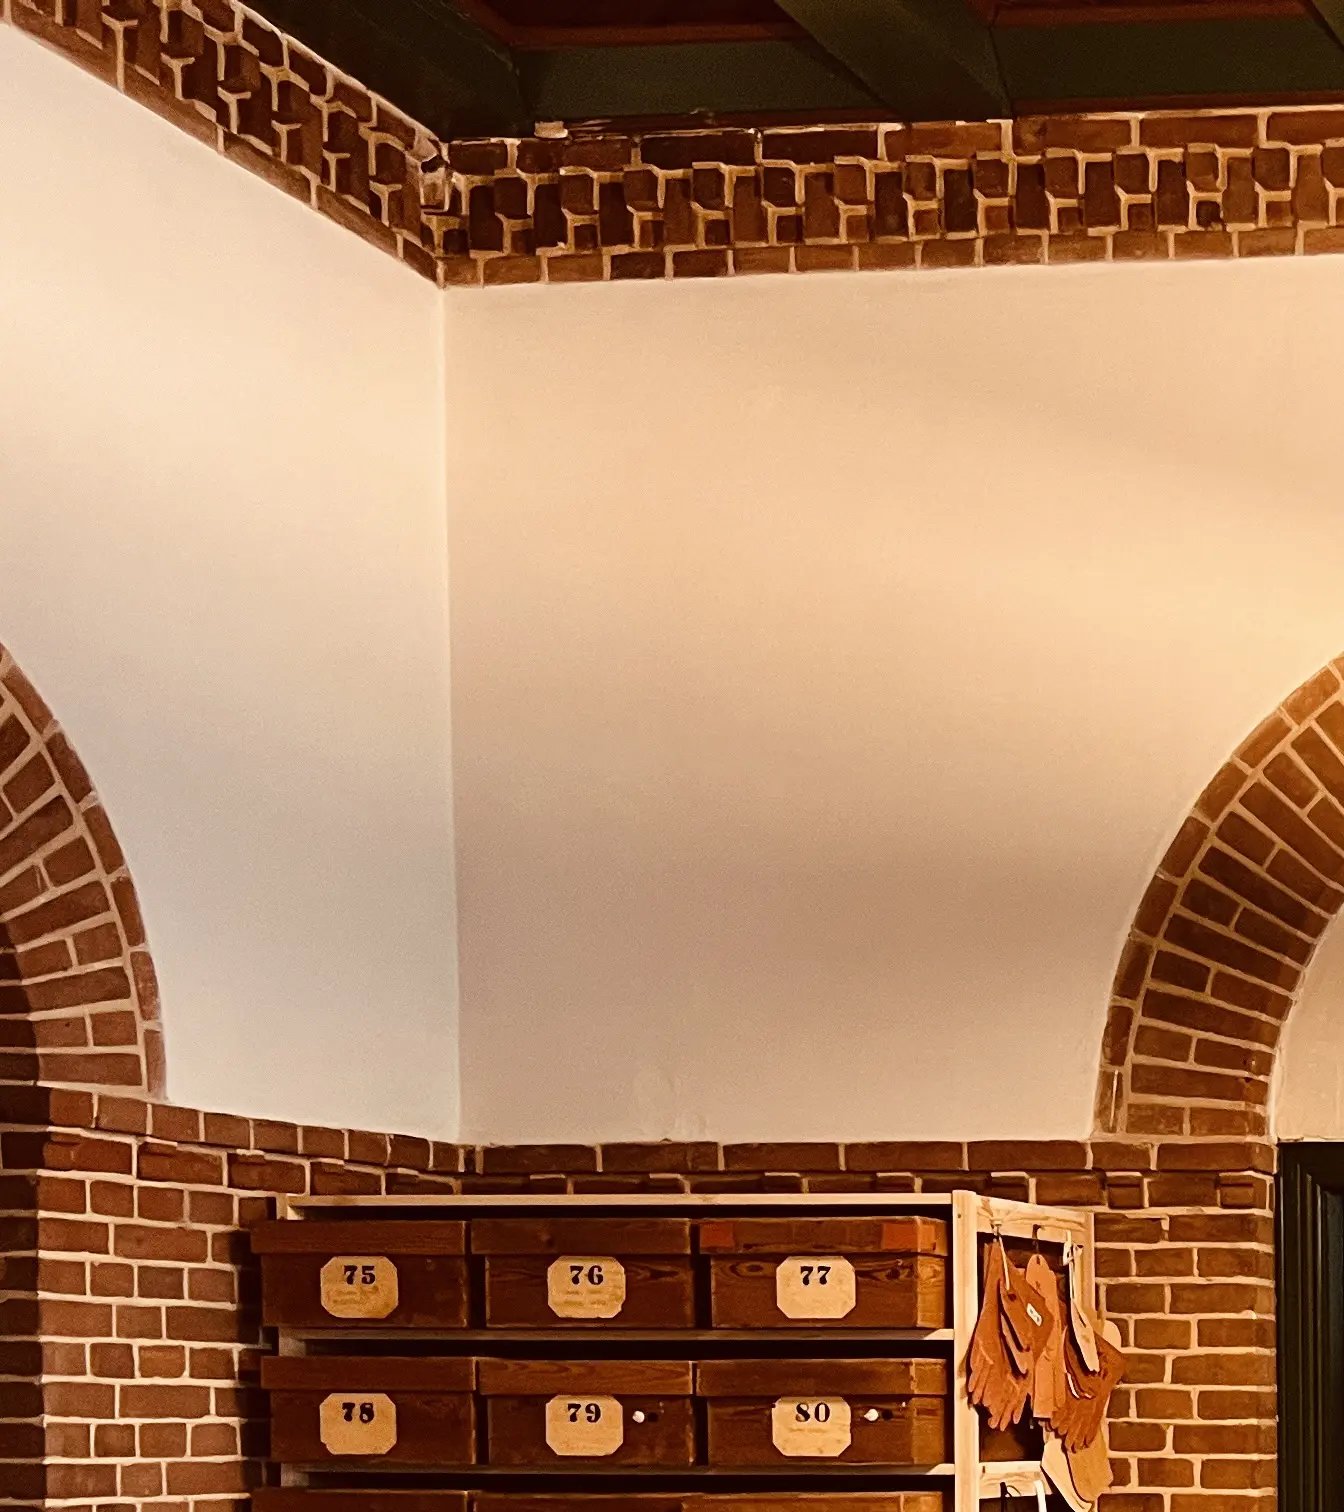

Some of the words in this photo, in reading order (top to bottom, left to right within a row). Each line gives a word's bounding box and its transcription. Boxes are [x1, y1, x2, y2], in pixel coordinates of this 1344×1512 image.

[343, 1264, 376, 1285] 75
[569, 1264, 604, 1286] 76
[800, 1265, 832, 1286] 77
[341, 1401, 375, 1425] 78
[567, 1402, 602, 1423] 79
[794, 1402, 833, 1423] 80
